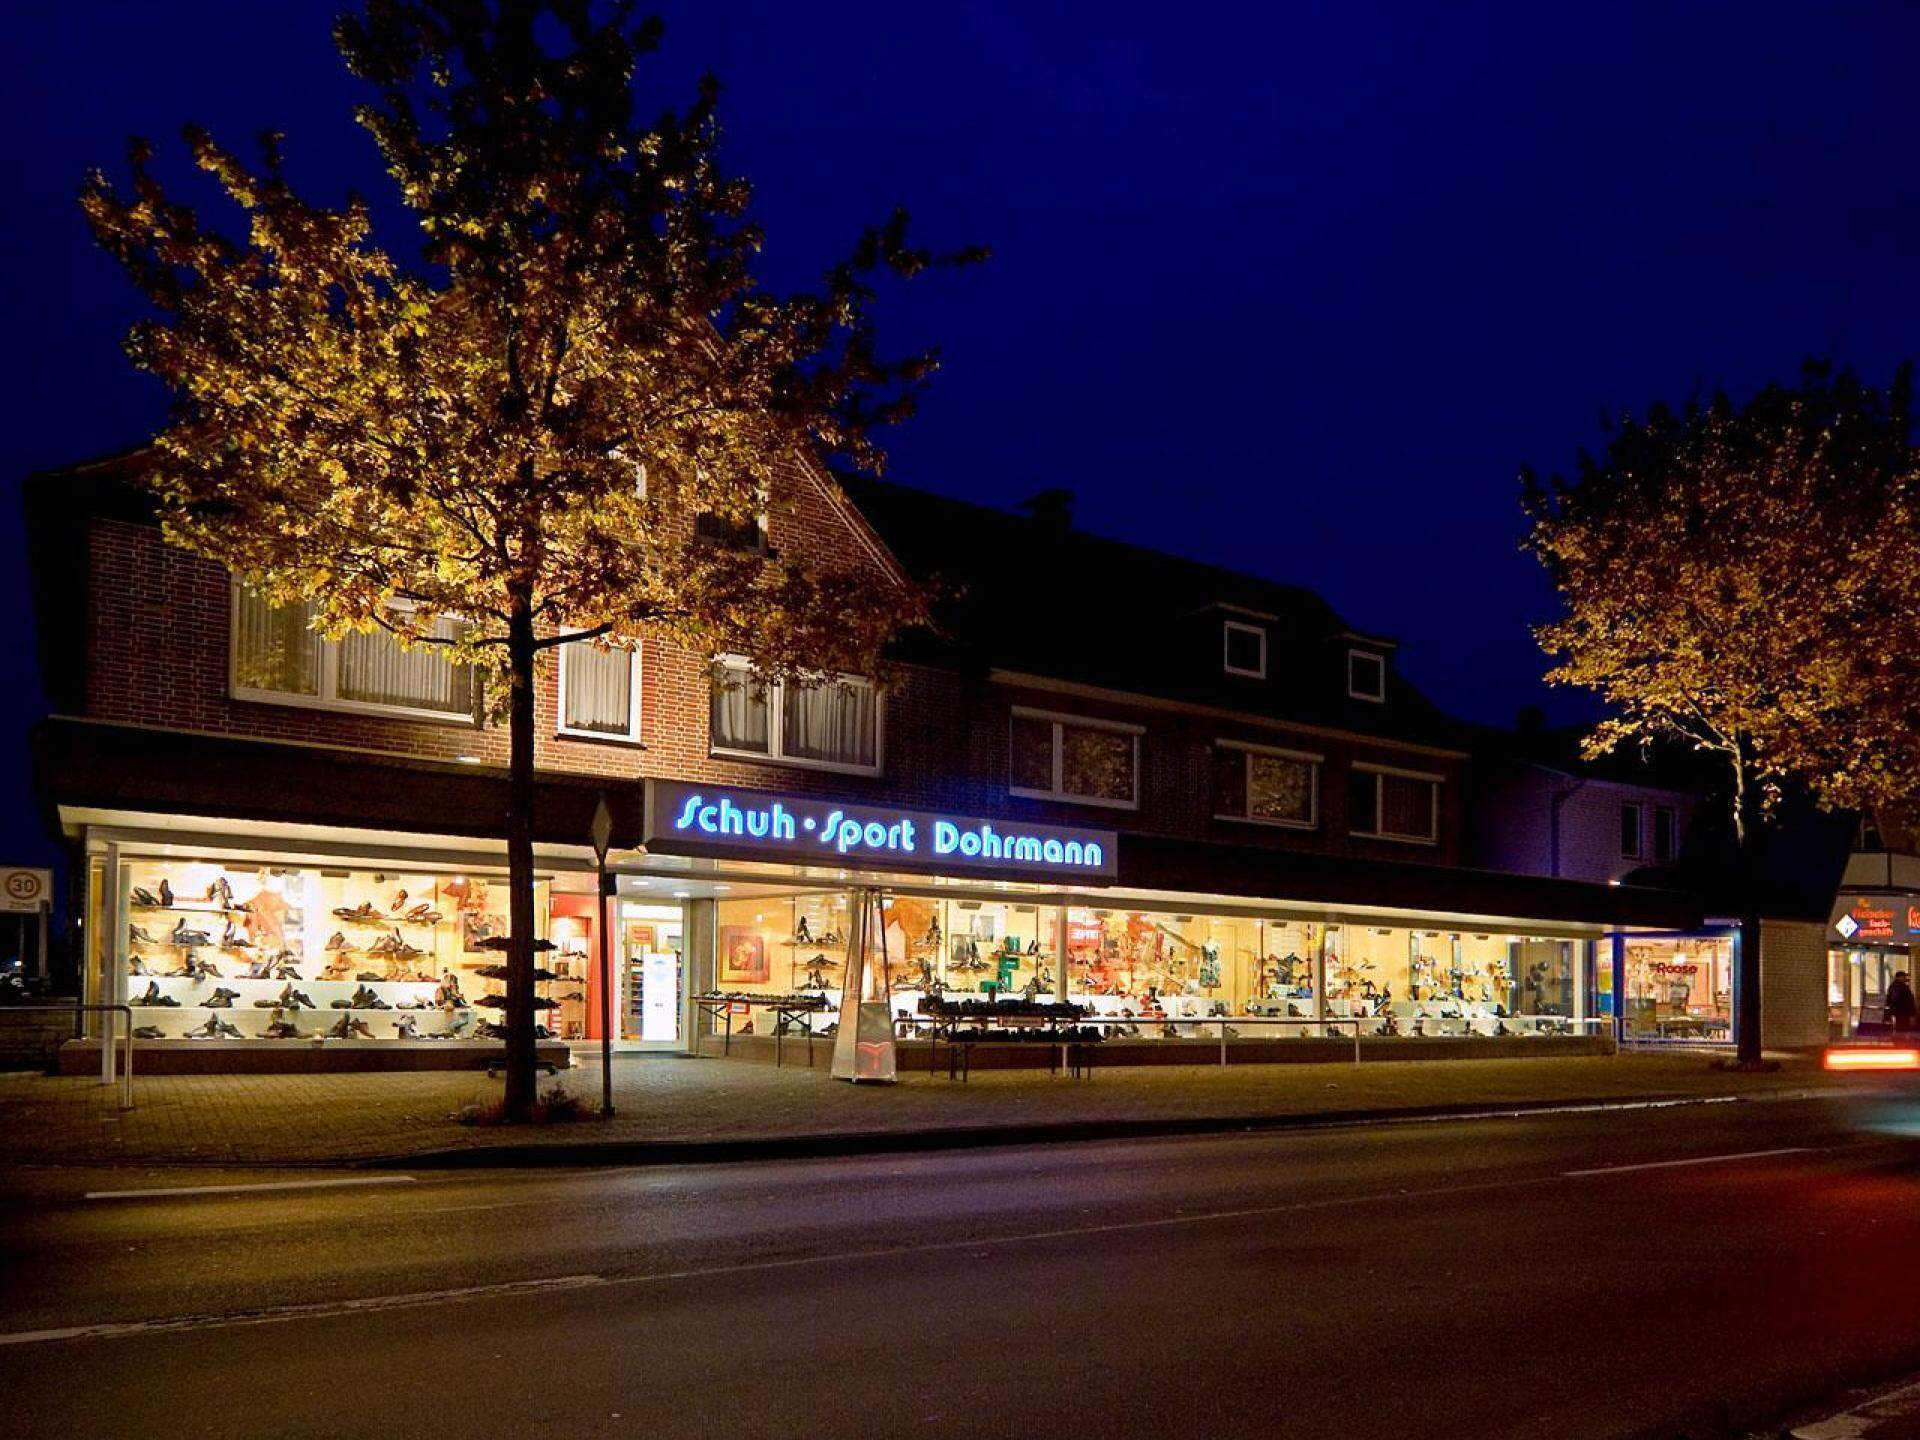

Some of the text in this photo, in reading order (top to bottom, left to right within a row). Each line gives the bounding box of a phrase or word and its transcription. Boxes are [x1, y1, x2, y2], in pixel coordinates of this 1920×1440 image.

[677, 796, 1102, 865] Schuh Sport Dohrmann
[13, 879, 34, 892] 30
